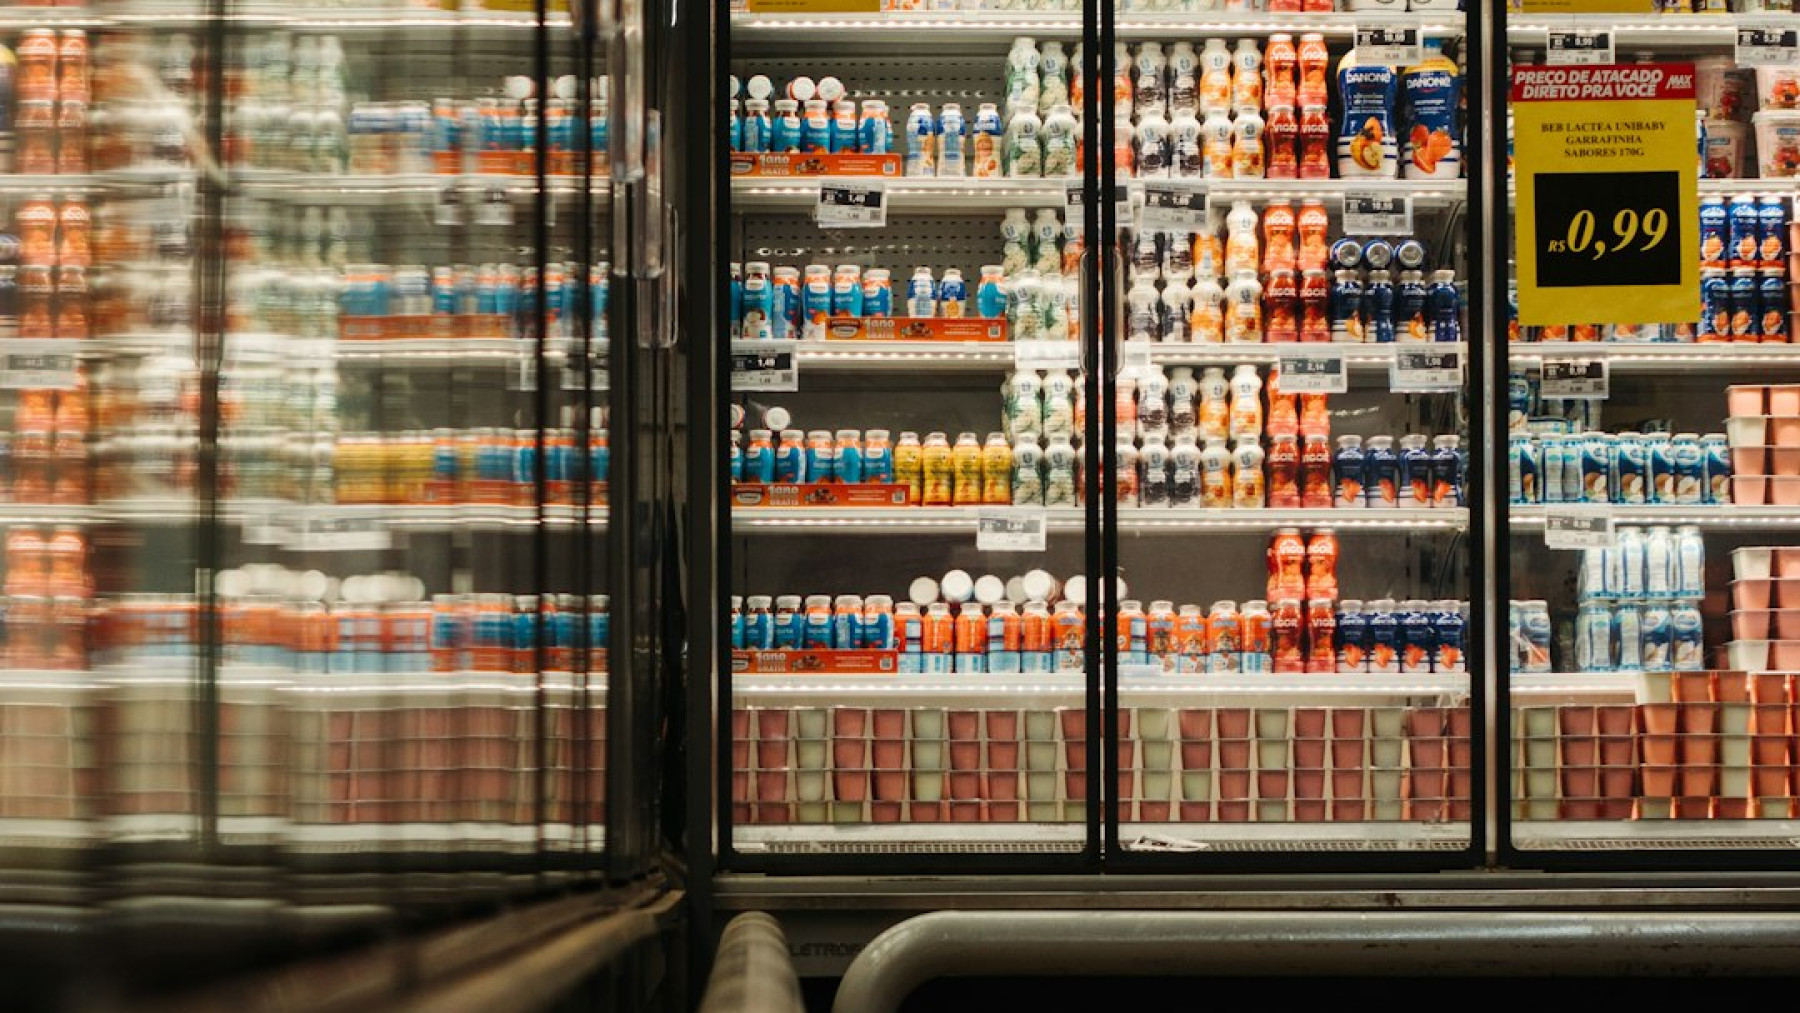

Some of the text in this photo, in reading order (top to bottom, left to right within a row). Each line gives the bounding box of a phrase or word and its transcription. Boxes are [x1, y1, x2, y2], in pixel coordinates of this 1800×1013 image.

[1346, 72, 1390, 84] DANONE
[1406, 77, 1452, 89] DANONE
[1514, 69, 1664, 85] PREÇO DE ATACADO
[1521, 84, 1581, 99] DIRETO
[1581, 84, 1614, 98] PRA
[1541, 121, 1667, 132] BEB LACTEA UNIBABY
[1566, 135, 1643, 145] GARRAFINHA
[1564, 147, 1617, 157] SABORES
[1567, 208, 1669, 260] 0,99
